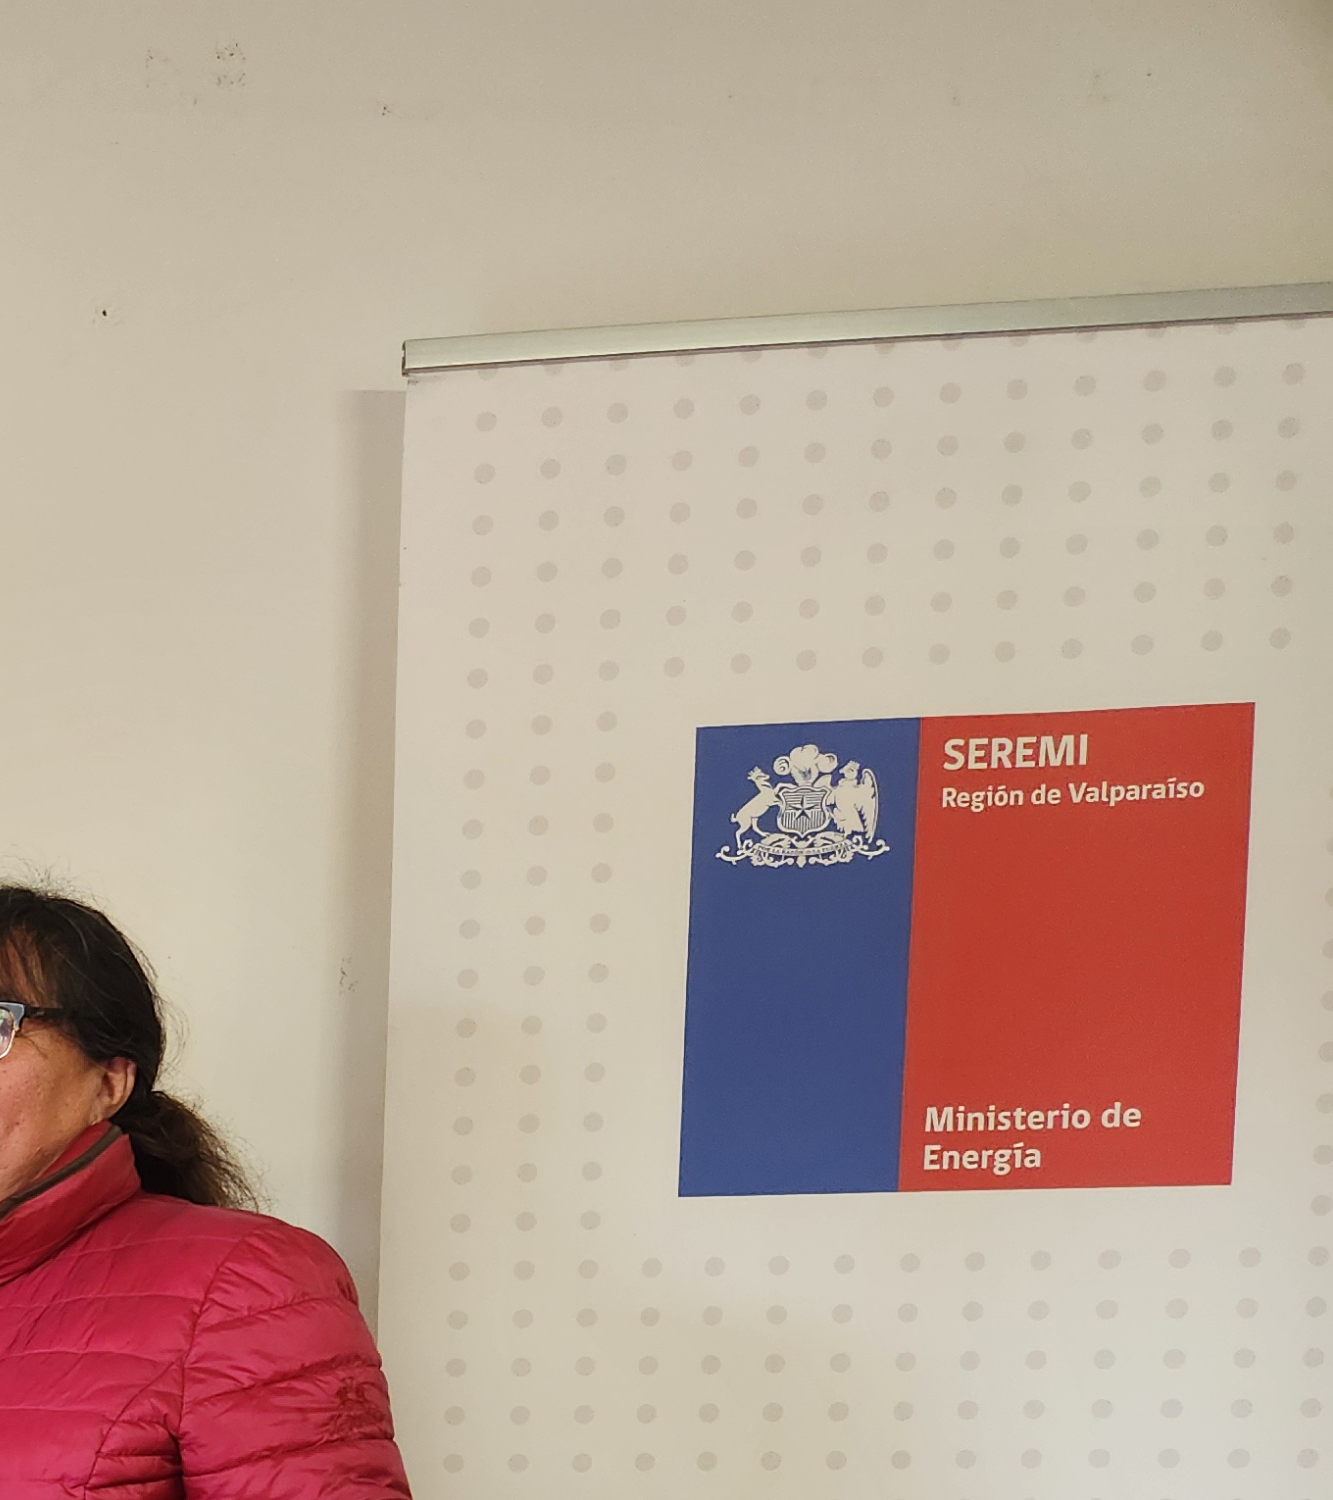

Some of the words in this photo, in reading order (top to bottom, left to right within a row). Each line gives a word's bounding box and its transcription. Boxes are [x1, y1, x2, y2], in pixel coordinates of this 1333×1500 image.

[942, 733, 1089, 771] SEREMI
[941, 784, 1024, 813] Región
[1030, 783, 1062, 805] de
[1068, 776, 1205, 807] Valparaíso
[924, 1102, 1091, 1133] Ministerio
[1101, 1101, 1142, 1128] de
[923, 1141, 1042, 1176] Energía
